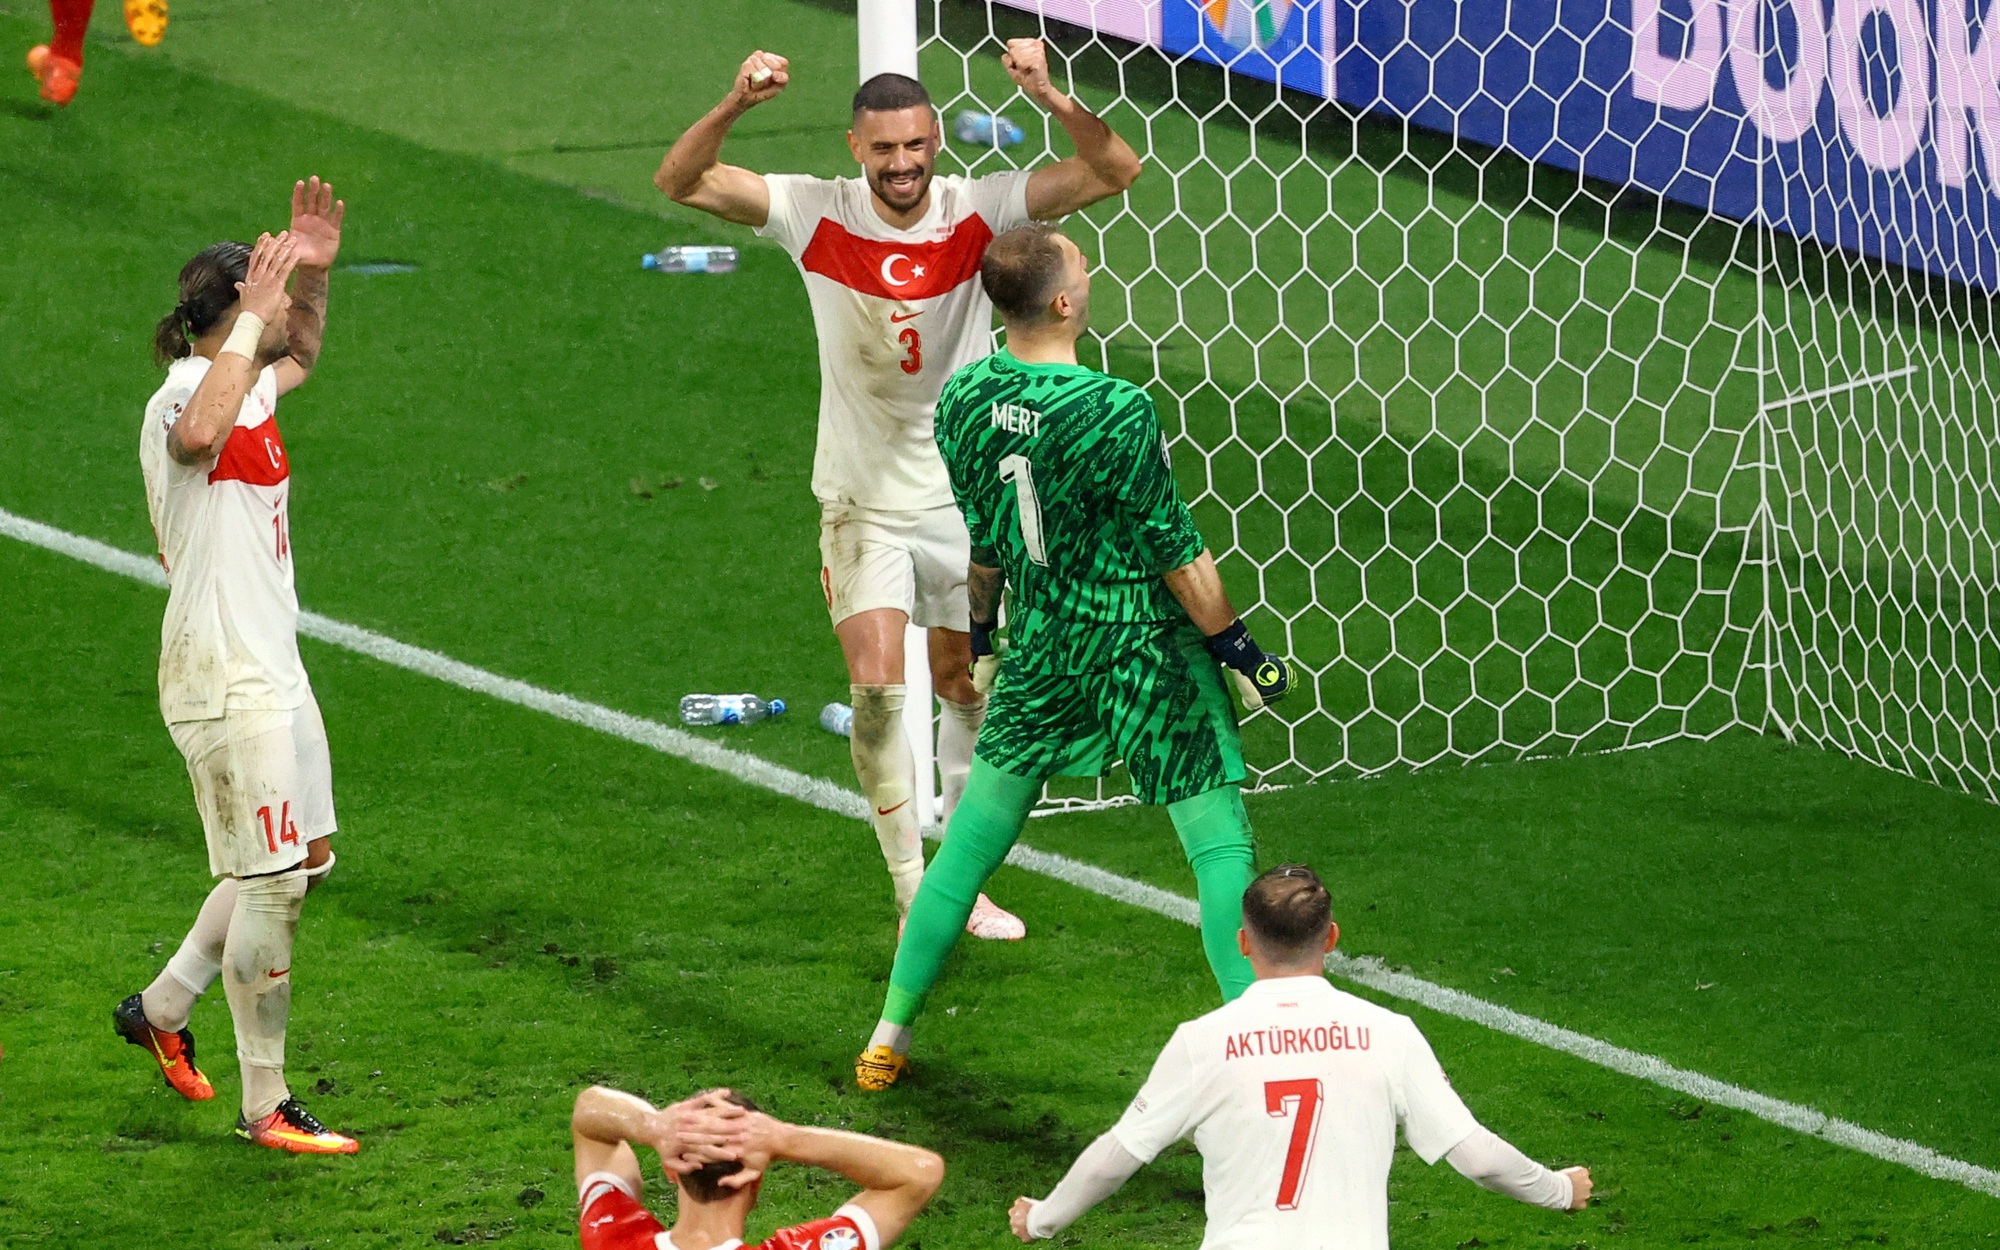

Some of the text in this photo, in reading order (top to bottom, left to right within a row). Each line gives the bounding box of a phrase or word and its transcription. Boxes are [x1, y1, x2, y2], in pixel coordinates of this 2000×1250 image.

[899, 328, 922, 375] 3
[990, 402, 1042, 438] MERT
[998, 453, 1049, 567] 1
[256, 801, 299, 854] 14
[1225, 1021, 1371, 1061] AKTÜRKOĞLU
[1264, 1078, 1324, 1211] 7
